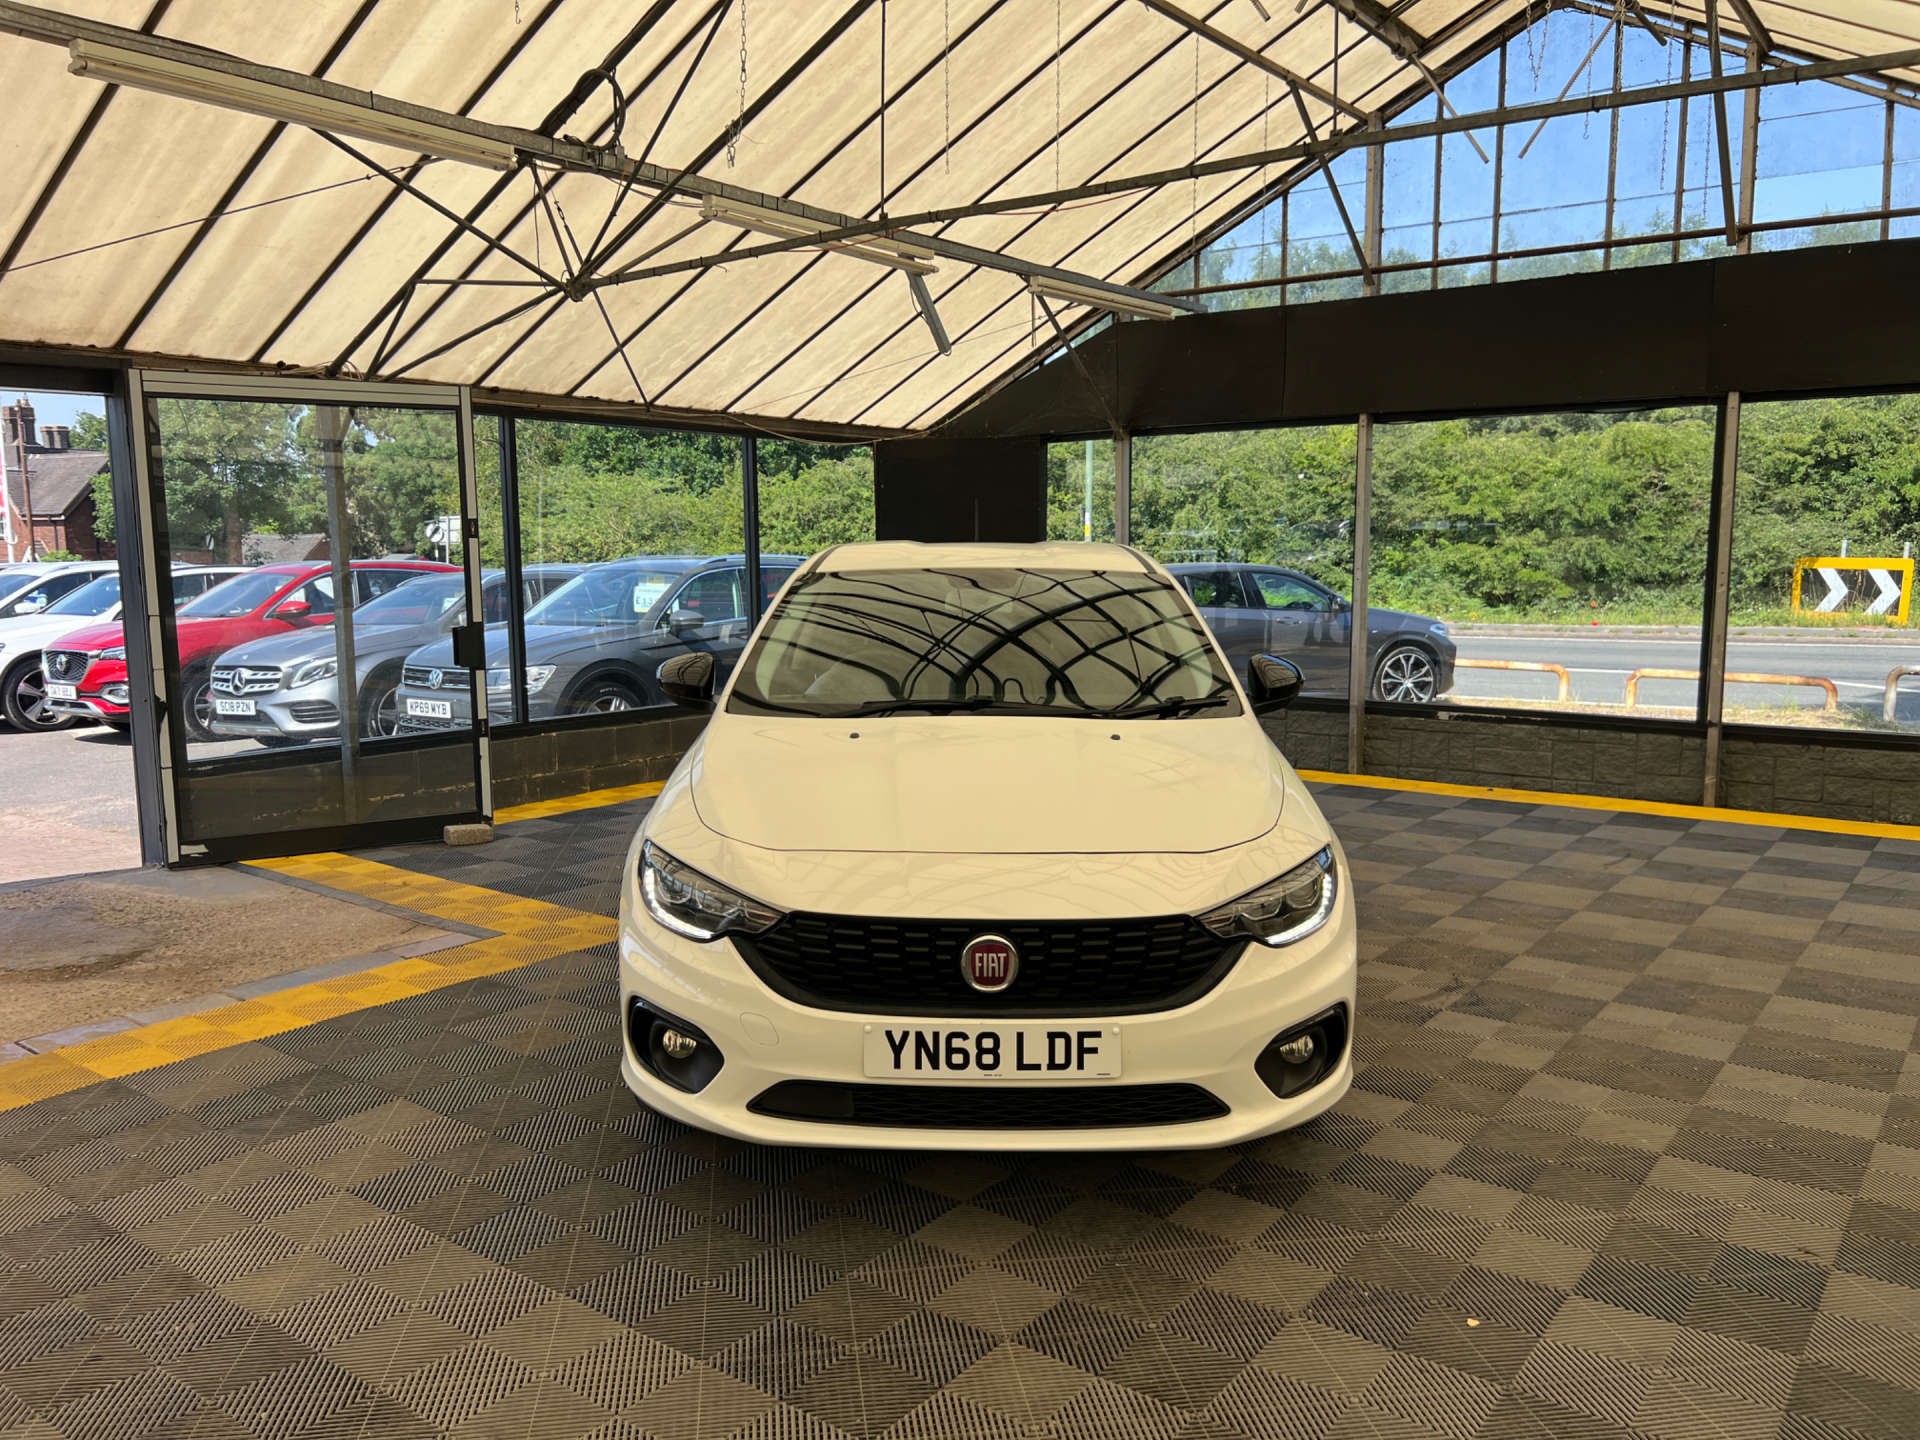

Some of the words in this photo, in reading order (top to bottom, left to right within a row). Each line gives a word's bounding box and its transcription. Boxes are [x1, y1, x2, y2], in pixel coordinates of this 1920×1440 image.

[975, 952, 1007, 977] FIAT
[885, 1030, 1001, 1071] YN68
[1016, 1031, 1102, 1071] LDF
